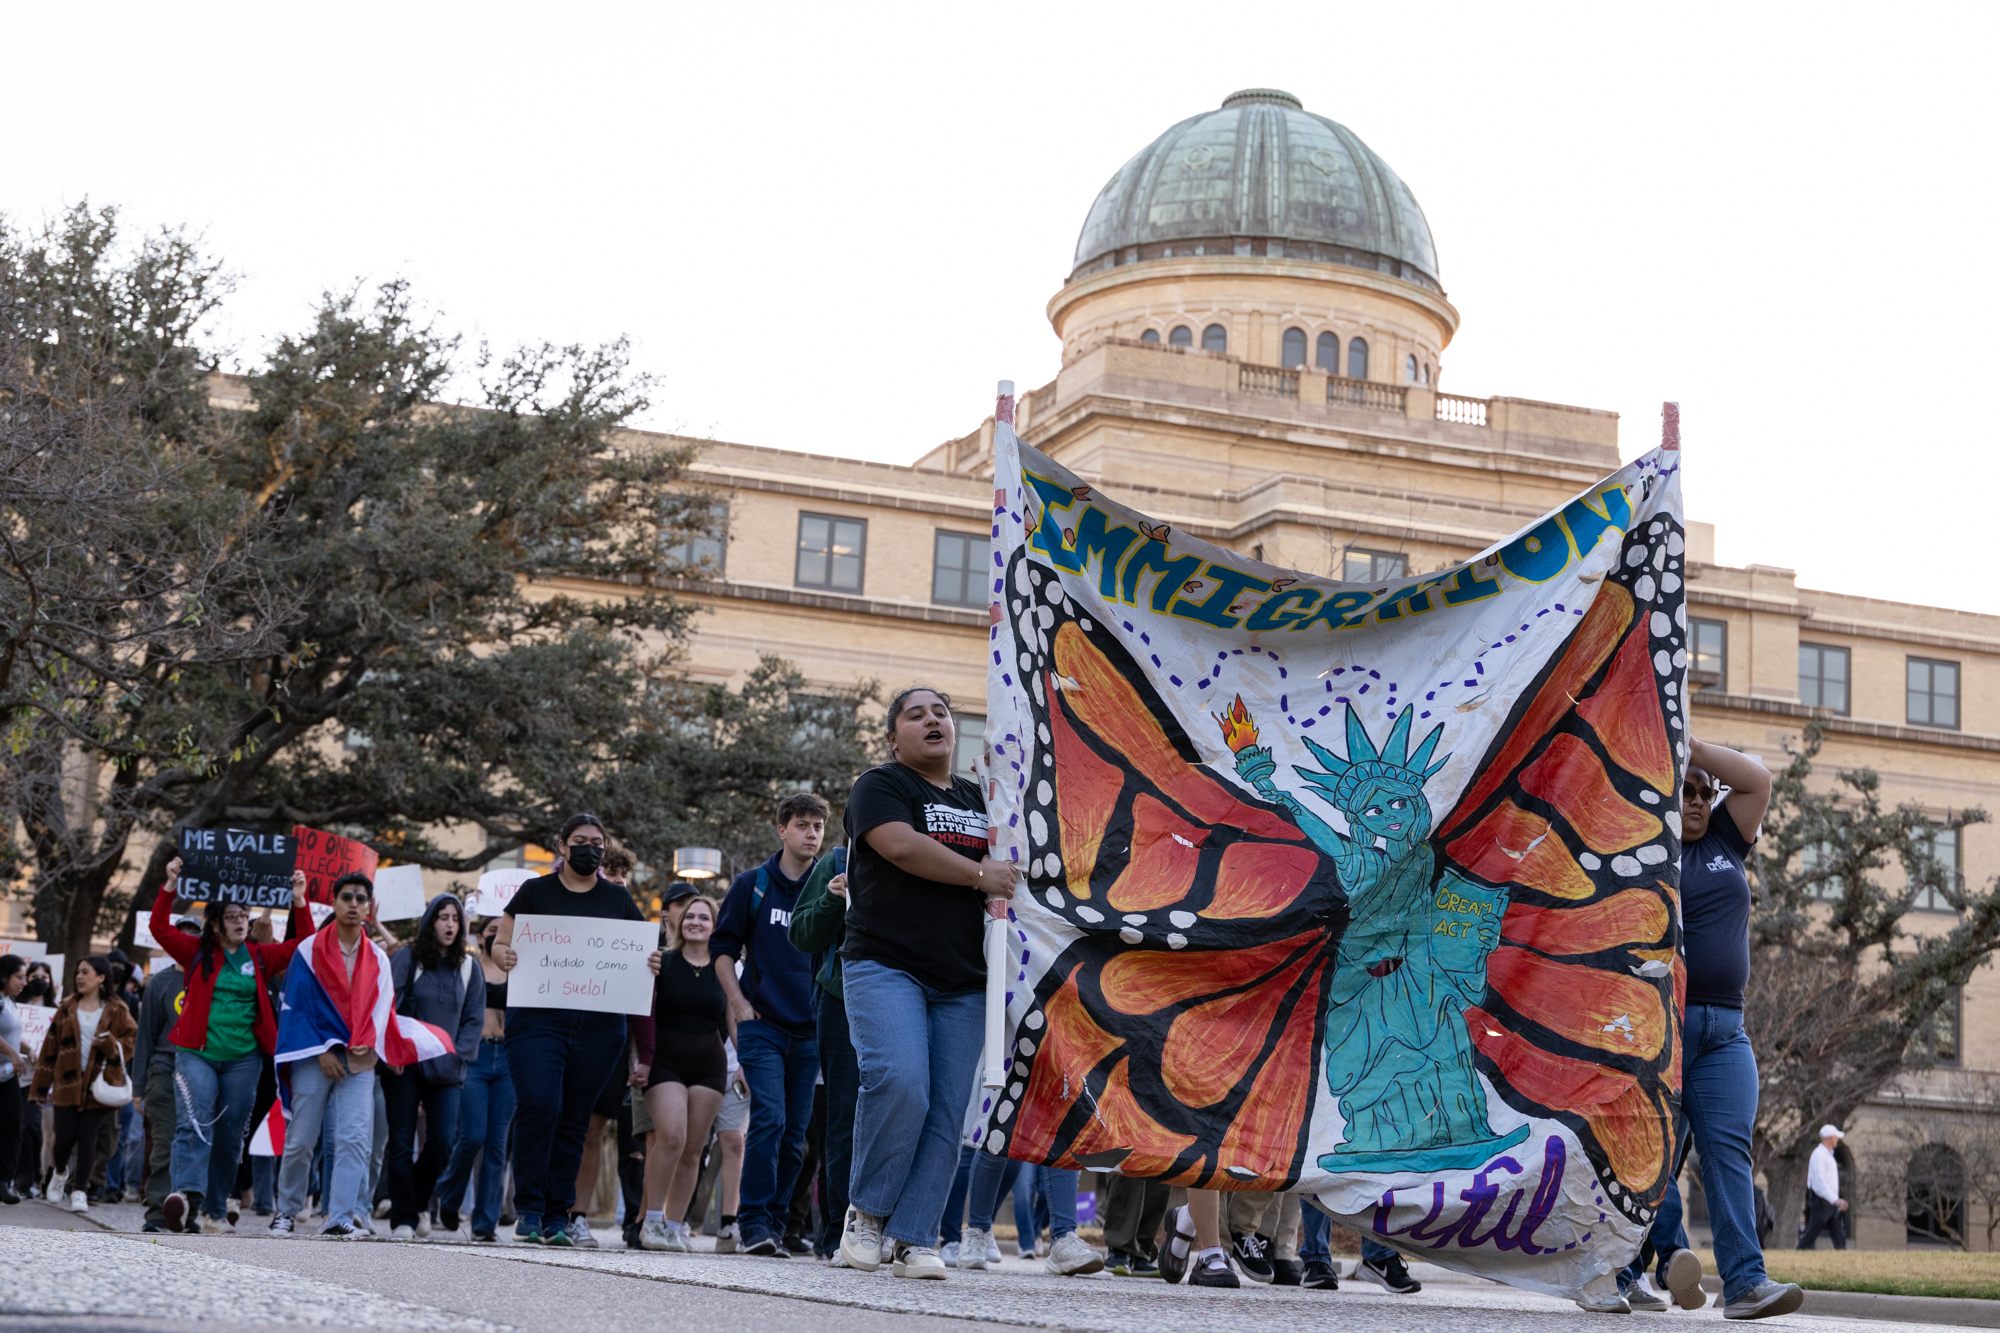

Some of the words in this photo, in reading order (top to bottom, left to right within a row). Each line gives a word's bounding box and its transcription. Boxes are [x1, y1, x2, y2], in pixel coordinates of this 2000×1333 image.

[925, 811, 970, 826] STAND
[926, 821, 966, 834] WITH
[184, 829, 215, 850] ME
[226, 832, 285, 854] VALE
[295, 826, 317, 850] NO
[325, 836, 355, 862] ONE
[928, 832, 988, 850] IMMIGRA
[189, 853, 198, 866] SI
[205, 855, 218, 868] MI
[224, 856, 250, 871] PIEL
[230, 869, 240, 882] SI
[244, 872, 257, 885] MI
[177, 877, 211, 900] LES
[494, 884, 521, 900] NOT
[1436, 886, 1493, 916] DREAM
[516, 922, 571, 945] Arriba
[587, 937, 604, 948] no
[611, 938, 644, 952] esta
[1433, 919, 1473, 939] ACT
[540, 954, 585, 968] dividido
[595, 960, 628, 971] como
[538, 979, 550, 994] el
